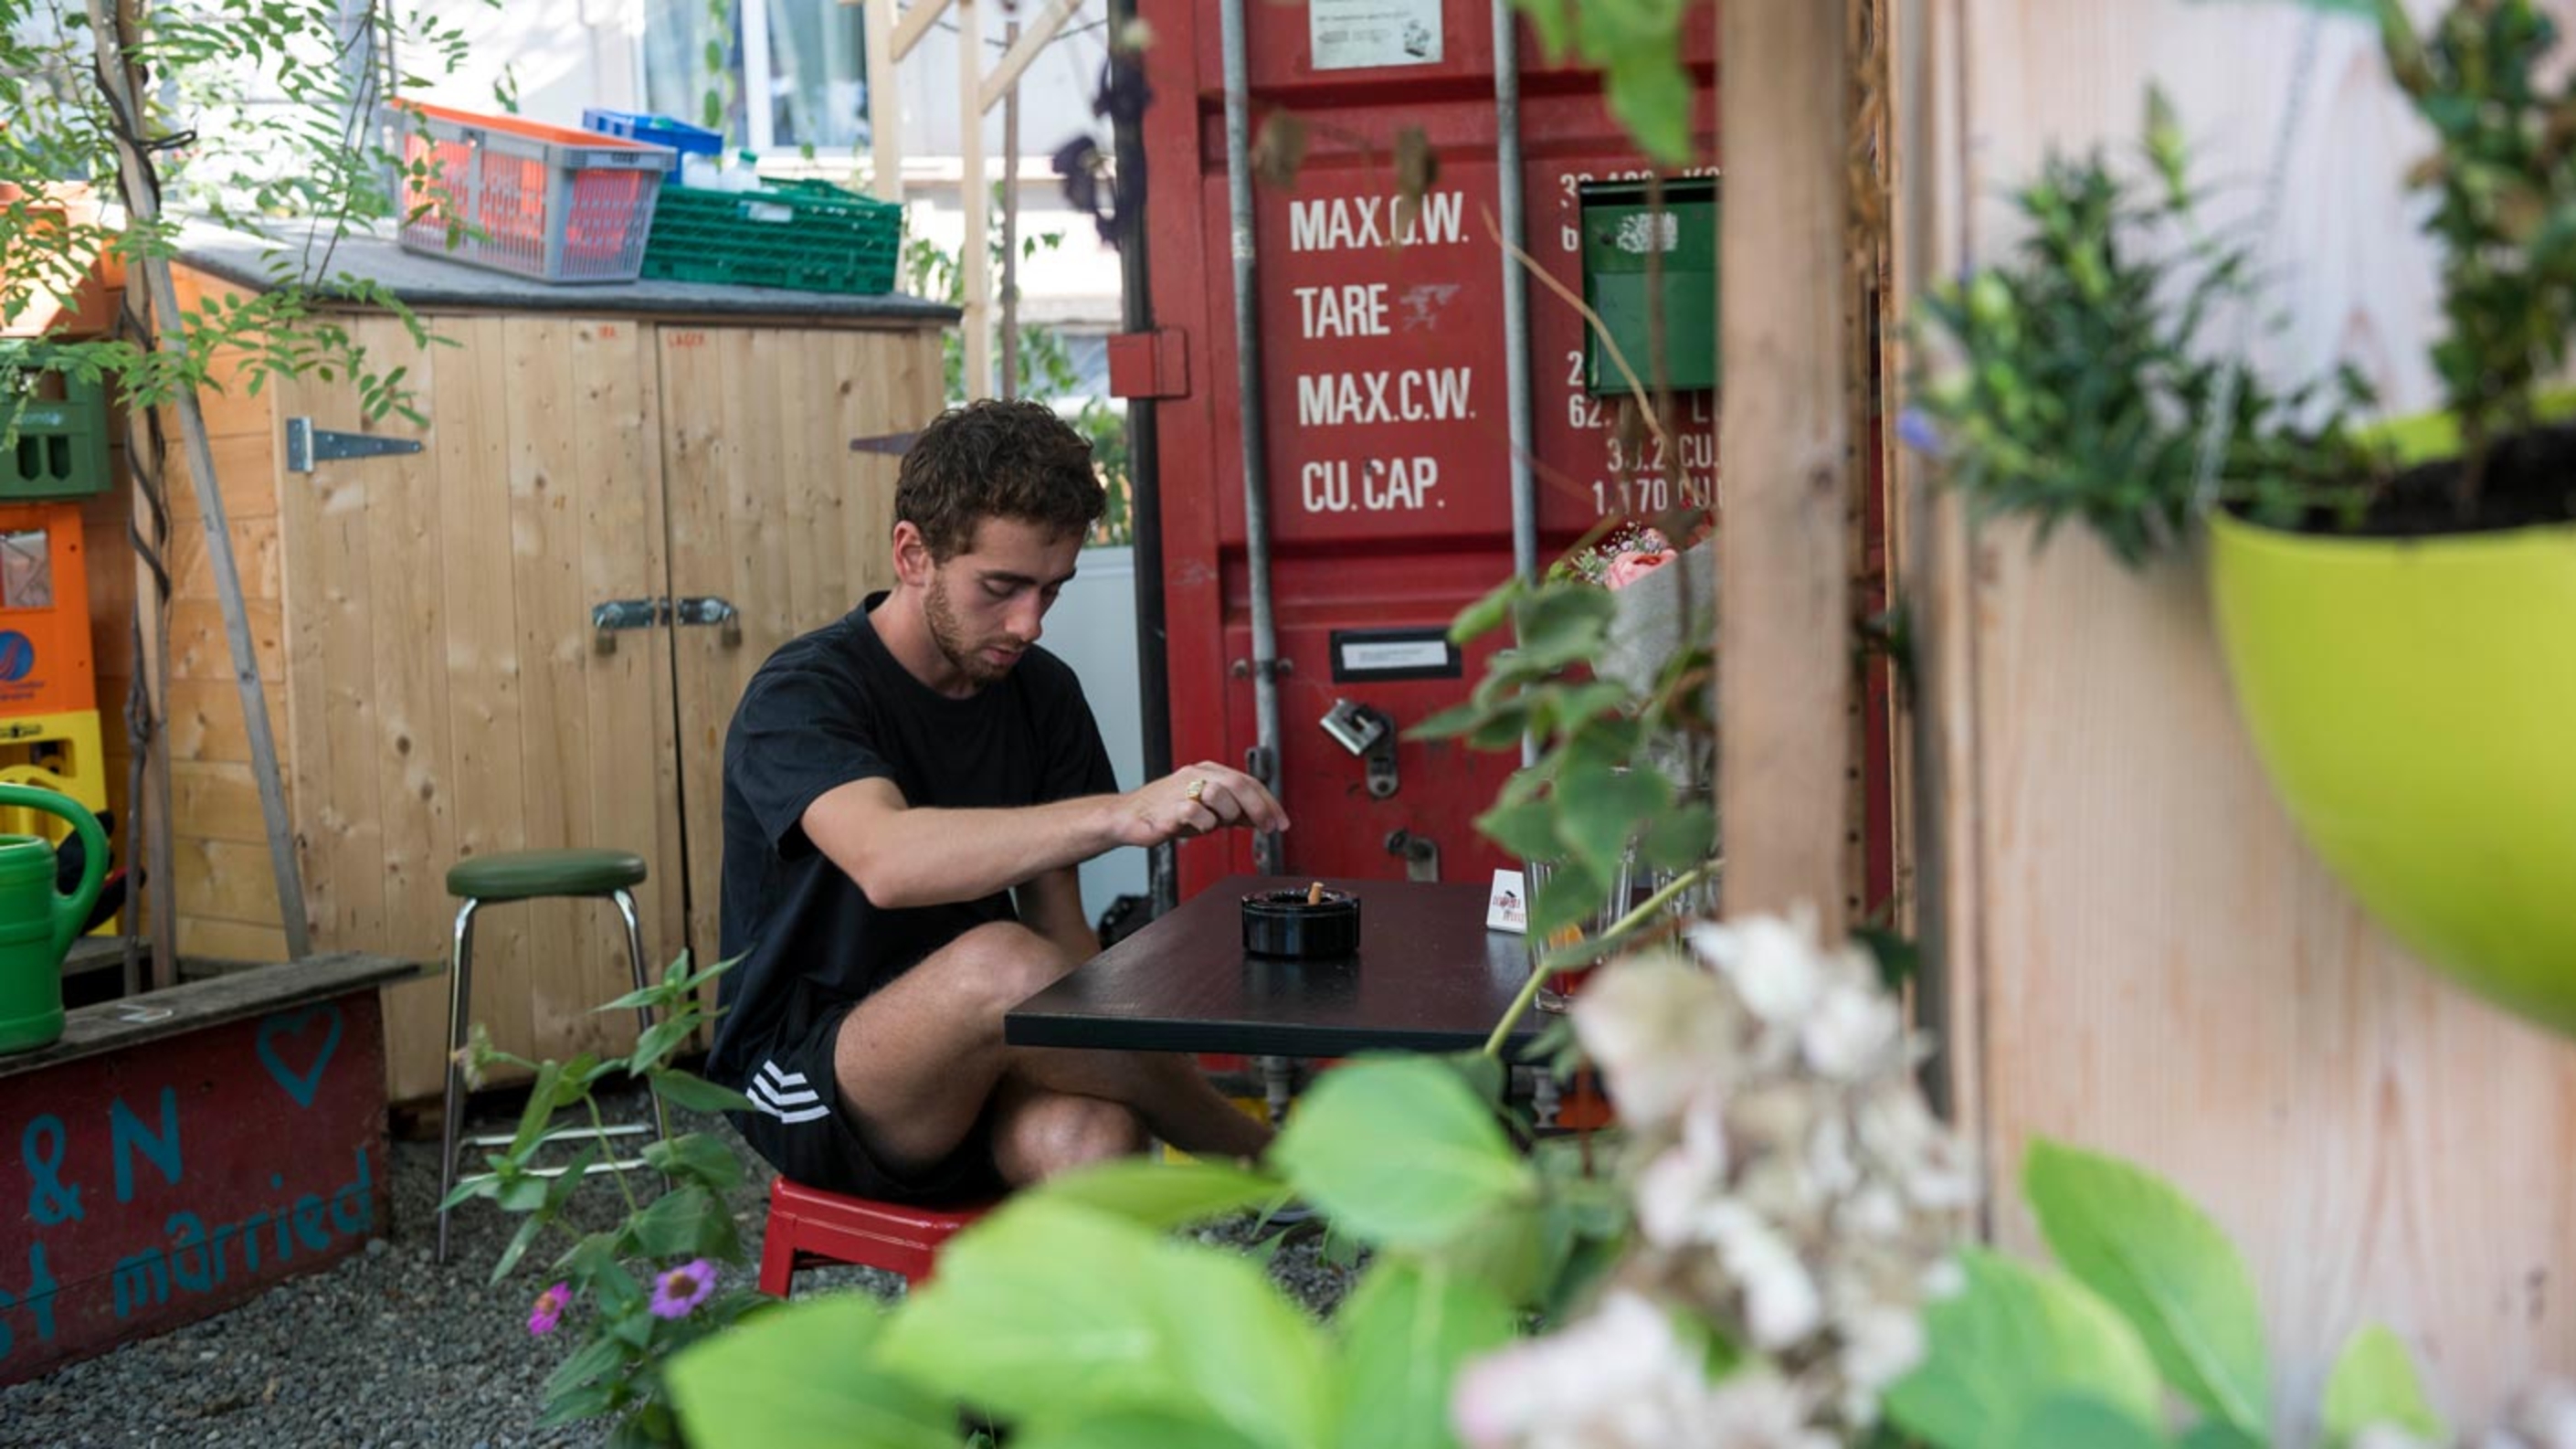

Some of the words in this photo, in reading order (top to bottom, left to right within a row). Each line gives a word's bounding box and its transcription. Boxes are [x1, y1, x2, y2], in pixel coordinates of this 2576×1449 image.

[1293, 282, 1391, 339] TARE
[1297, 366, 1476, 427] MAX.C.W.
[21, 1113, 85, 1225] &
[111, 1085, 183, 1204] N
[112, 1147, 375, 1318] married
